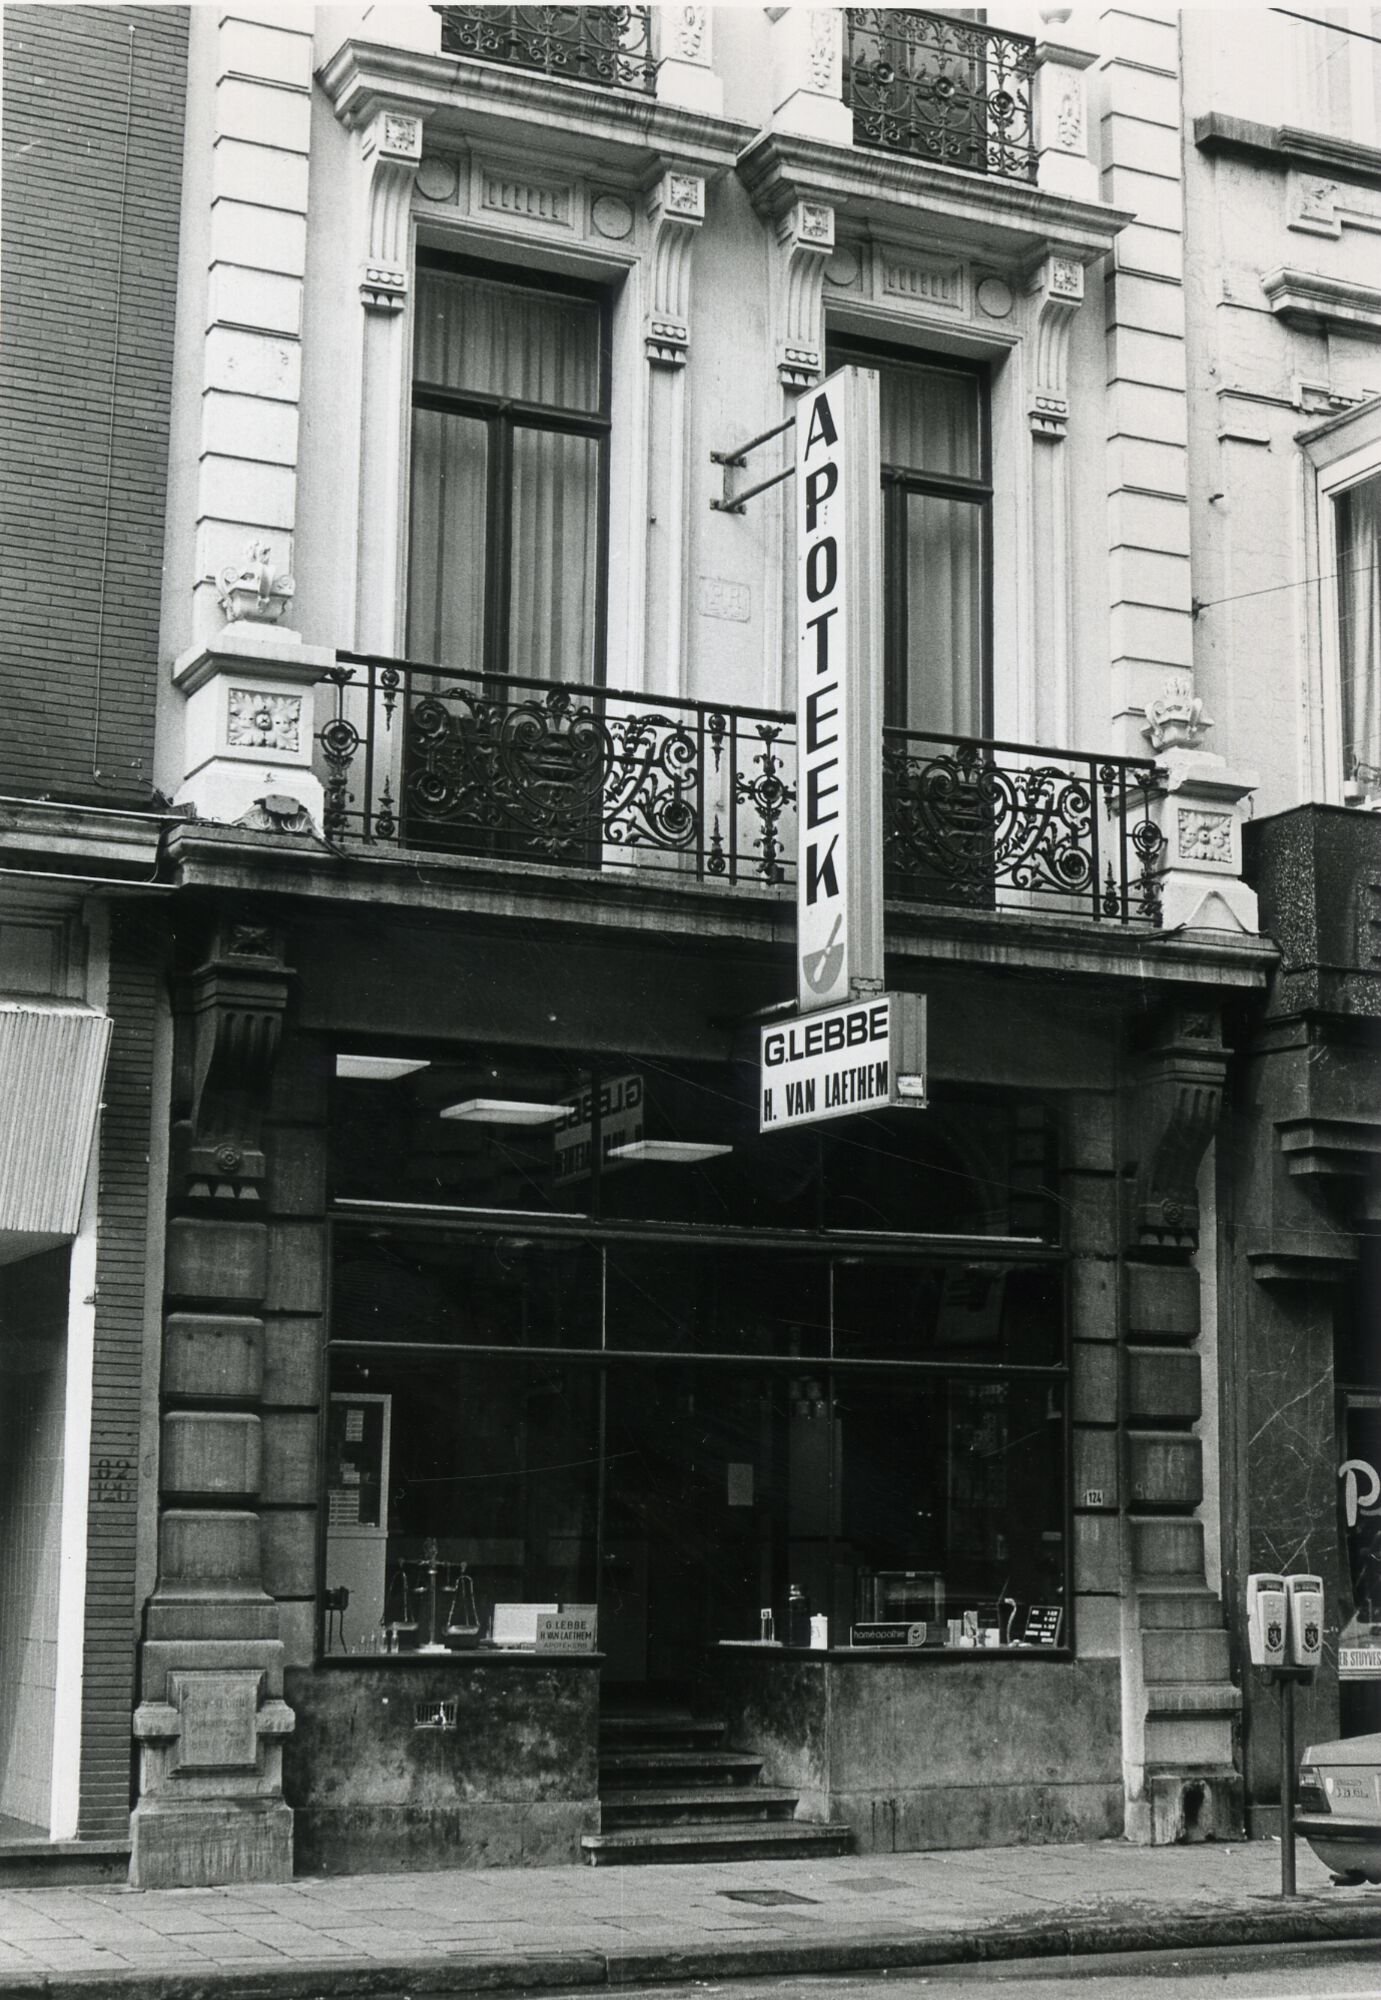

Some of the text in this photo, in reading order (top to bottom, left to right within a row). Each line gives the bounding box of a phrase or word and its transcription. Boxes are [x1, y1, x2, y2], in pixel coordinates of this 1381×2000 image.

[804, 392, 839, 906] APOTEEK
[765, 1004, 889, 1067] G.LEBBE
[764, 1061, 889, 1122] H. VAN LAETHEM
[1089, 1492, 1102, 1504] 124
[555, 1621, 586, 1629] LEBBE
[561, 1632, 591, 1640] LAETHEM
